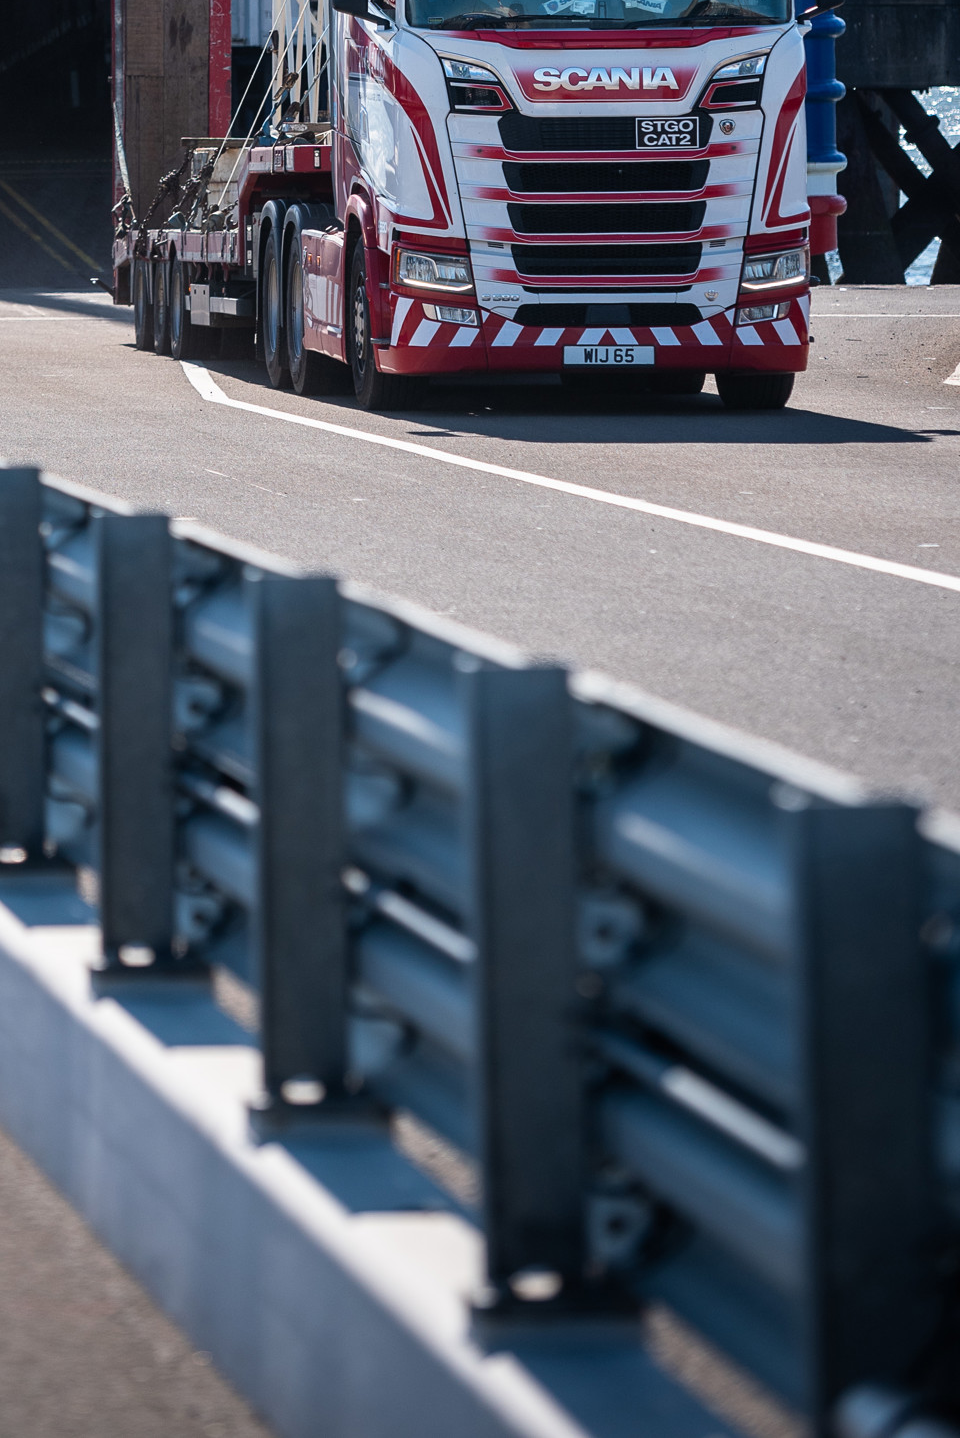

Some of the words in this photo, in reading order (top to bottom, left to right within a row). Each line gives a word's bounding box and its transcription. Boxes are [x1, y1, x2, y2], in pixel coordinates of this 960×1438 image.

[533, 66, 680, 92] SCANIA
[640, 120, 694, 133] STGO
[643, 133, 691, 146] CAT2
[584, 348, 609, 363] WIJ
[613, 348, 635, 363] 65
